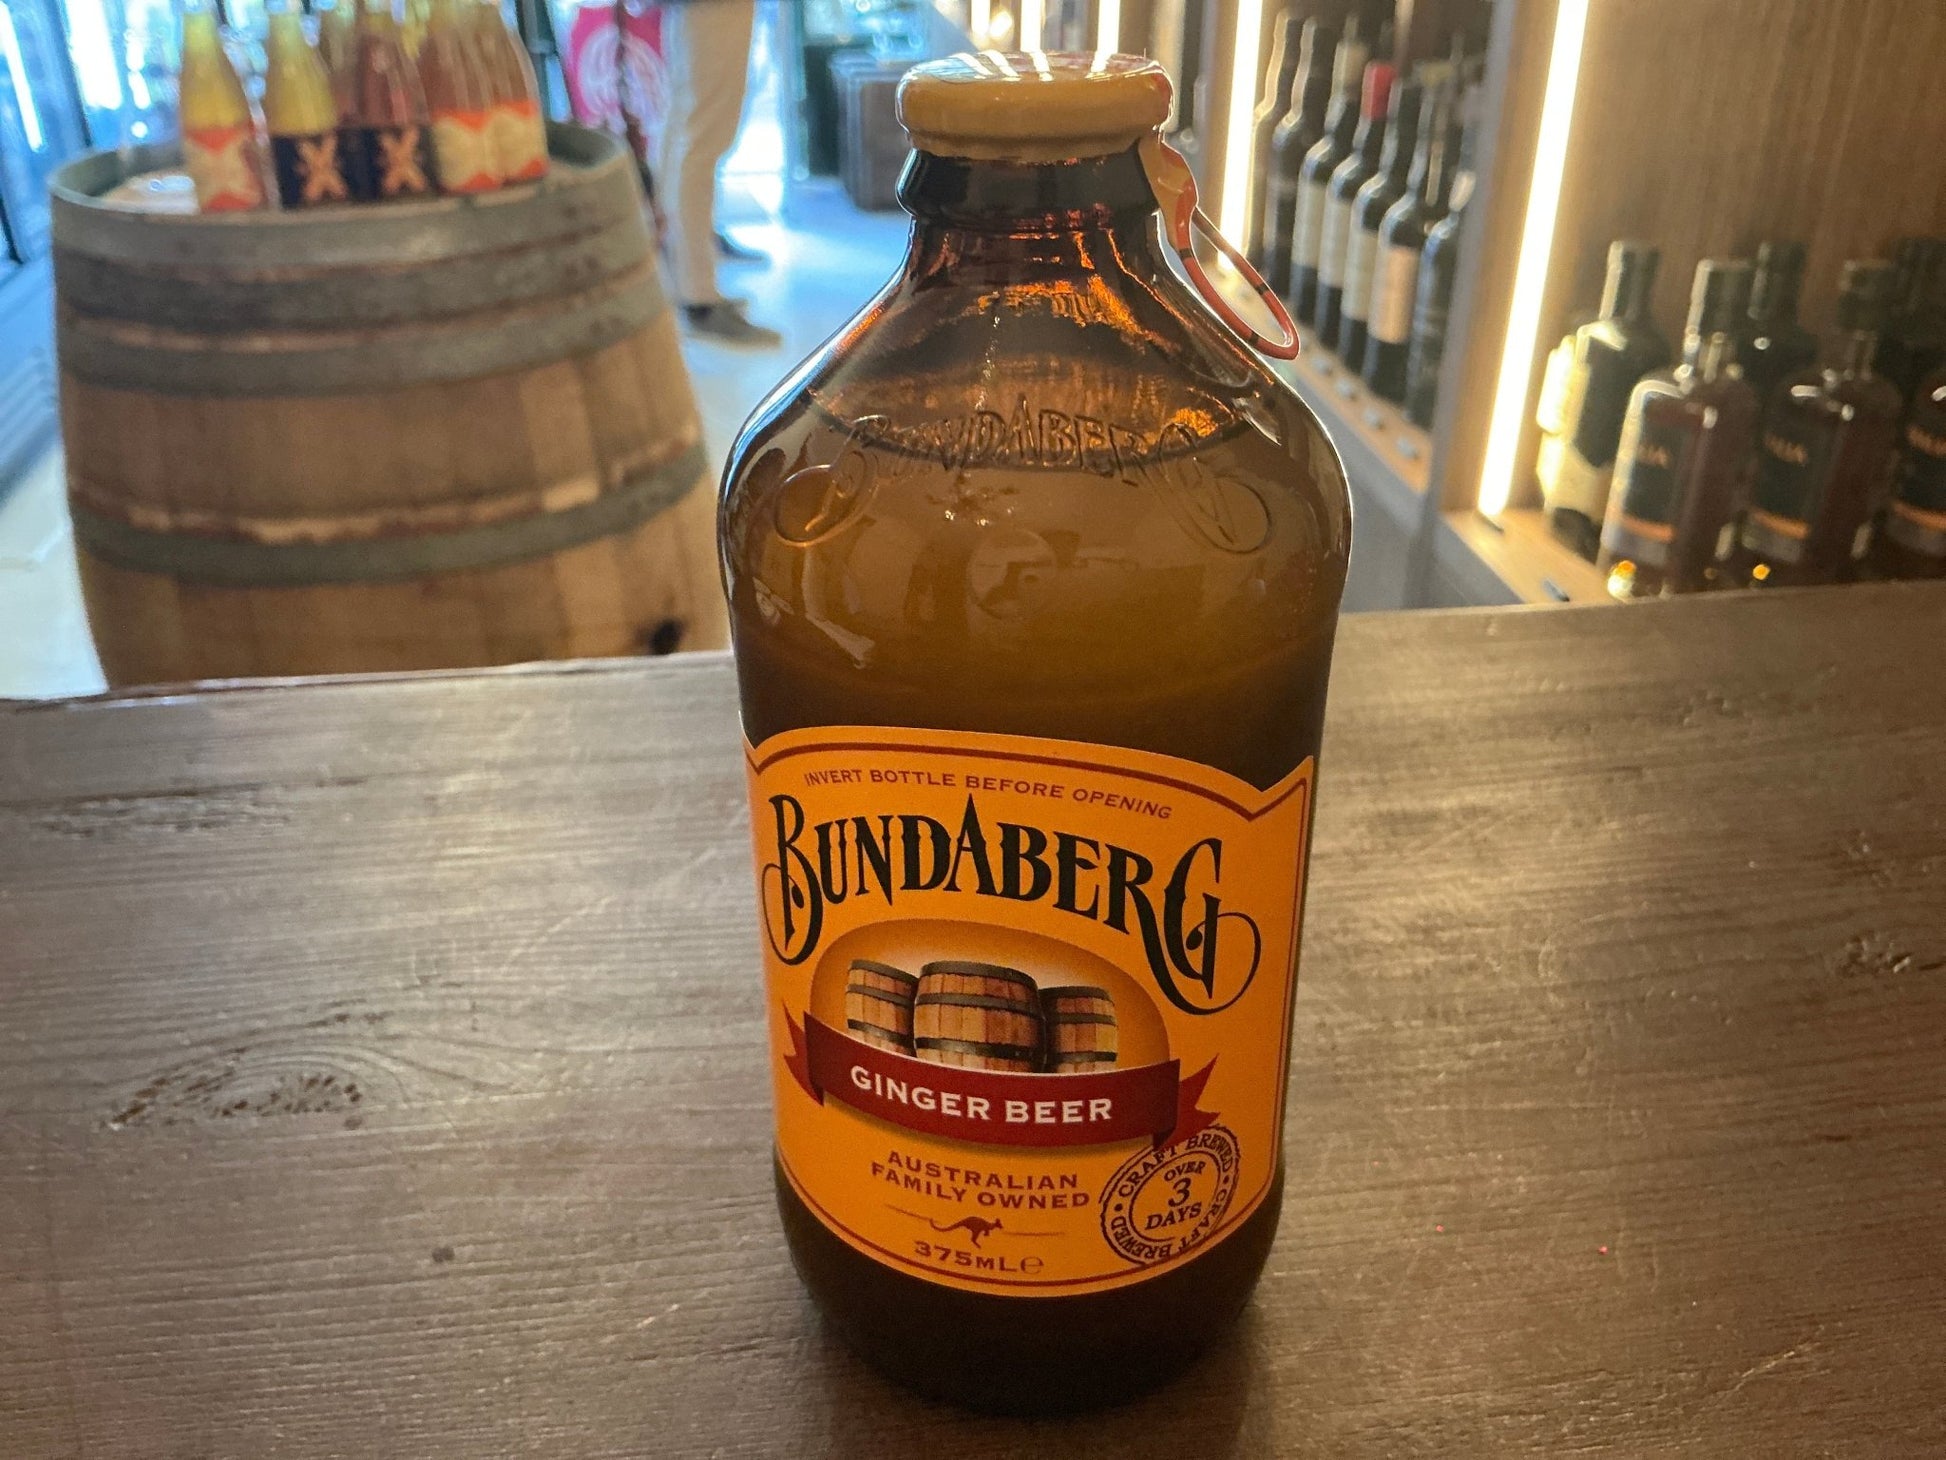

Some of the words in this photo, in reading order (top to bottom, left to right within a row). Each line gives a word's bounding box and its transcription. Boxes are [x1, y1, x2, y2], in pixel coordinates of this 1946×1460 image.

[804, 769, 862, 787] INVERT
[869, 769, 956, 787] BOTTLE
[965, 775, 1065, 798] BEFORE
[1072, 788, 1173, 819] OPENING
[761, 793, 1262, 1016] BUNDABERG
[850, 1064, 990, 1121] GINGER
[1005, 1097, 1112, 1124] BEER
[871, 1161, 967, 1203] FAMILY
[977, 1191, 1090, 1209] OWNED
[888, 1150, 1078, 1190] AUSTRALIAN
[1118, 1145, 1177, 1197] CRAFT
[1185, 1132, 1234, 1173] BREWED
[1163, 1160, 1206, 1182] OVER
[1144, 1201, 1202, 1231] DAYS
[1167, 1177, 1191, 1207] 3
[1110, 1215, 1173, 1260] BREWED
[1178, 1188, 1228, 1251] CRAFT
